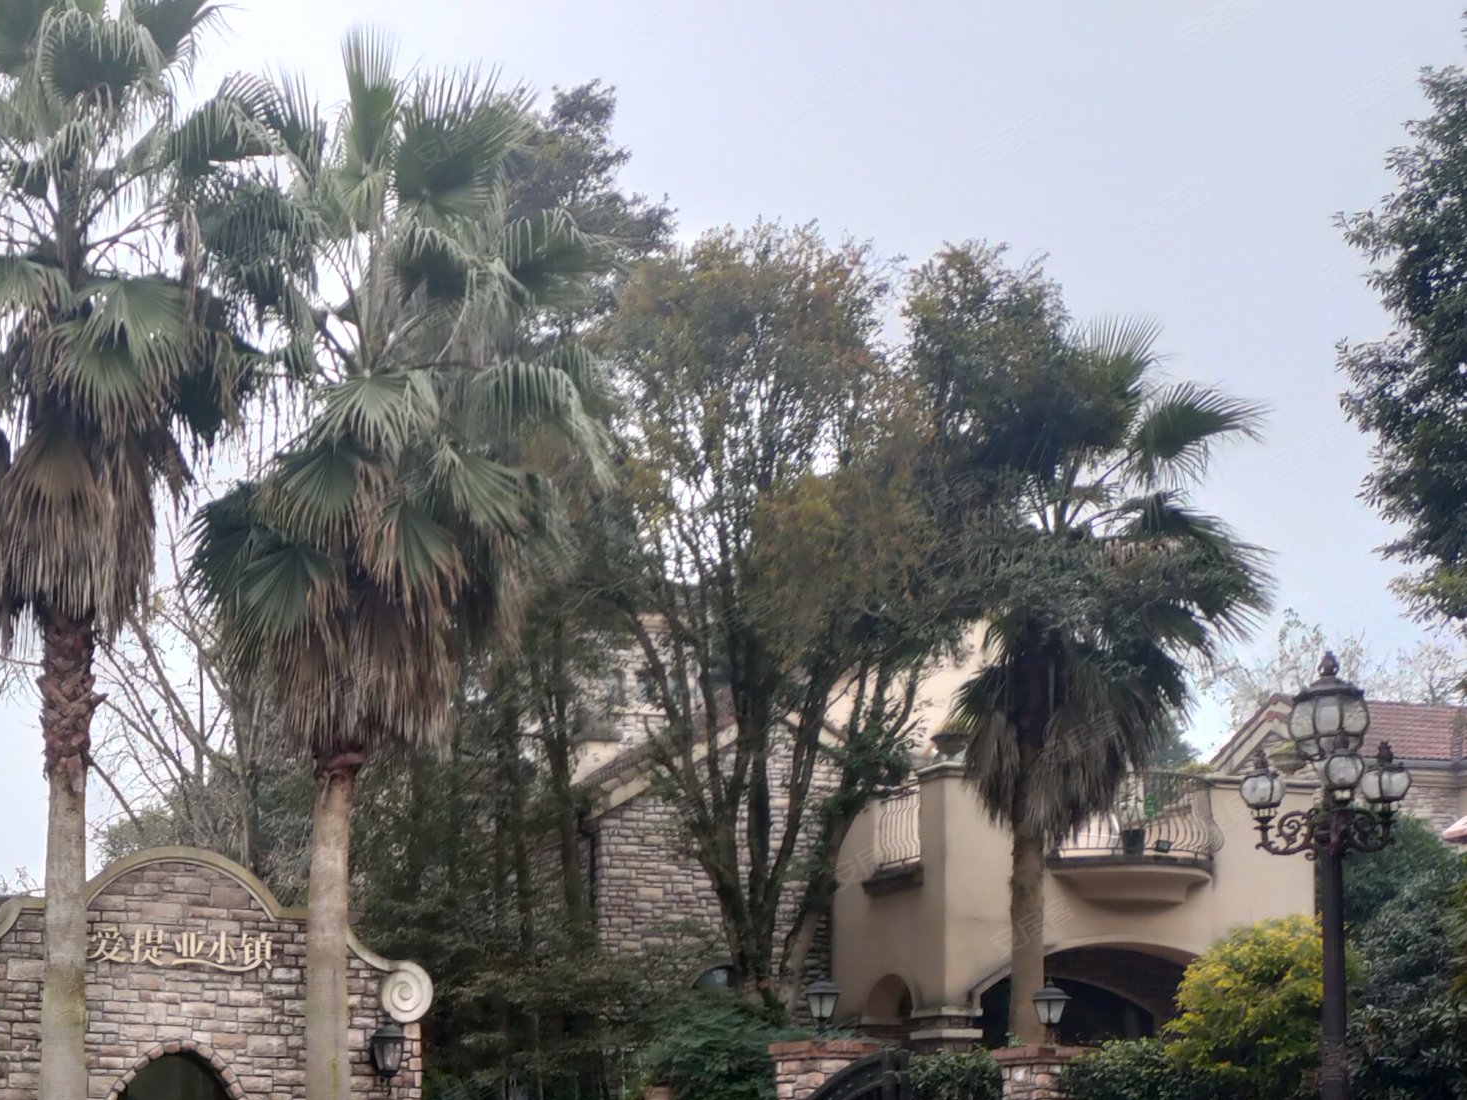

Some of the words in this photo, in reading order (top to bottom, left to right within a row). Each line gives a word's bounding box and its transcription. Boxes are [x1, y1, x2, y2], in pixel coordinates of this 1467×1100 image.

[86, 926, 273, 971] 爱提亚小镇
